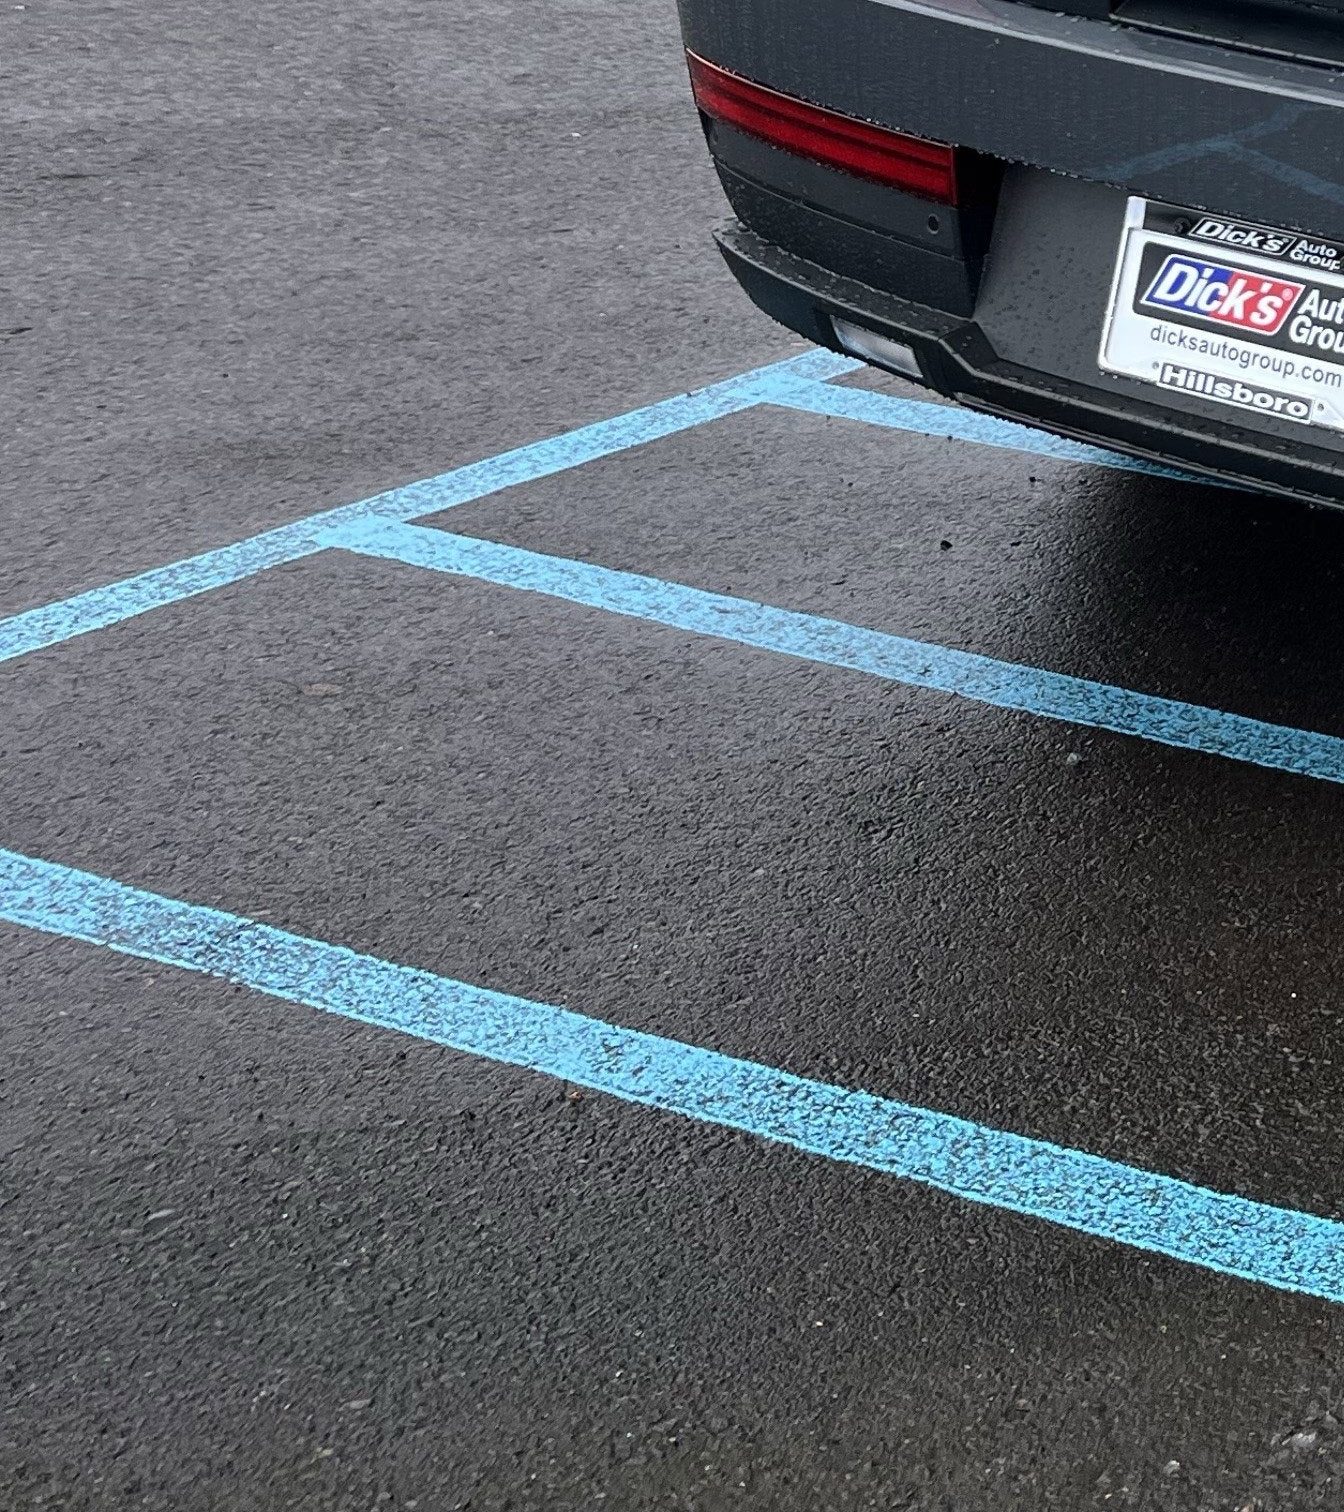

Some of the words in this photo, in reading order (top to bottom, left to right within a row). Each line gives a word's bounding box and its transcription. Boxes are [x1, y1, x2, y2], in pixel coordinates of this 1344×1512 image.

[1198, 218, 1288, 253] Dick's
[1297, 238, 1338, 257] Auto
[1289, 249, 1343, 272] Group
[1152, 258, 1286, 329] Dick's
[1149, 323, 1343, 389] dicksautogroup.com
[1160, 362, 1310, 419] Hillsboro
